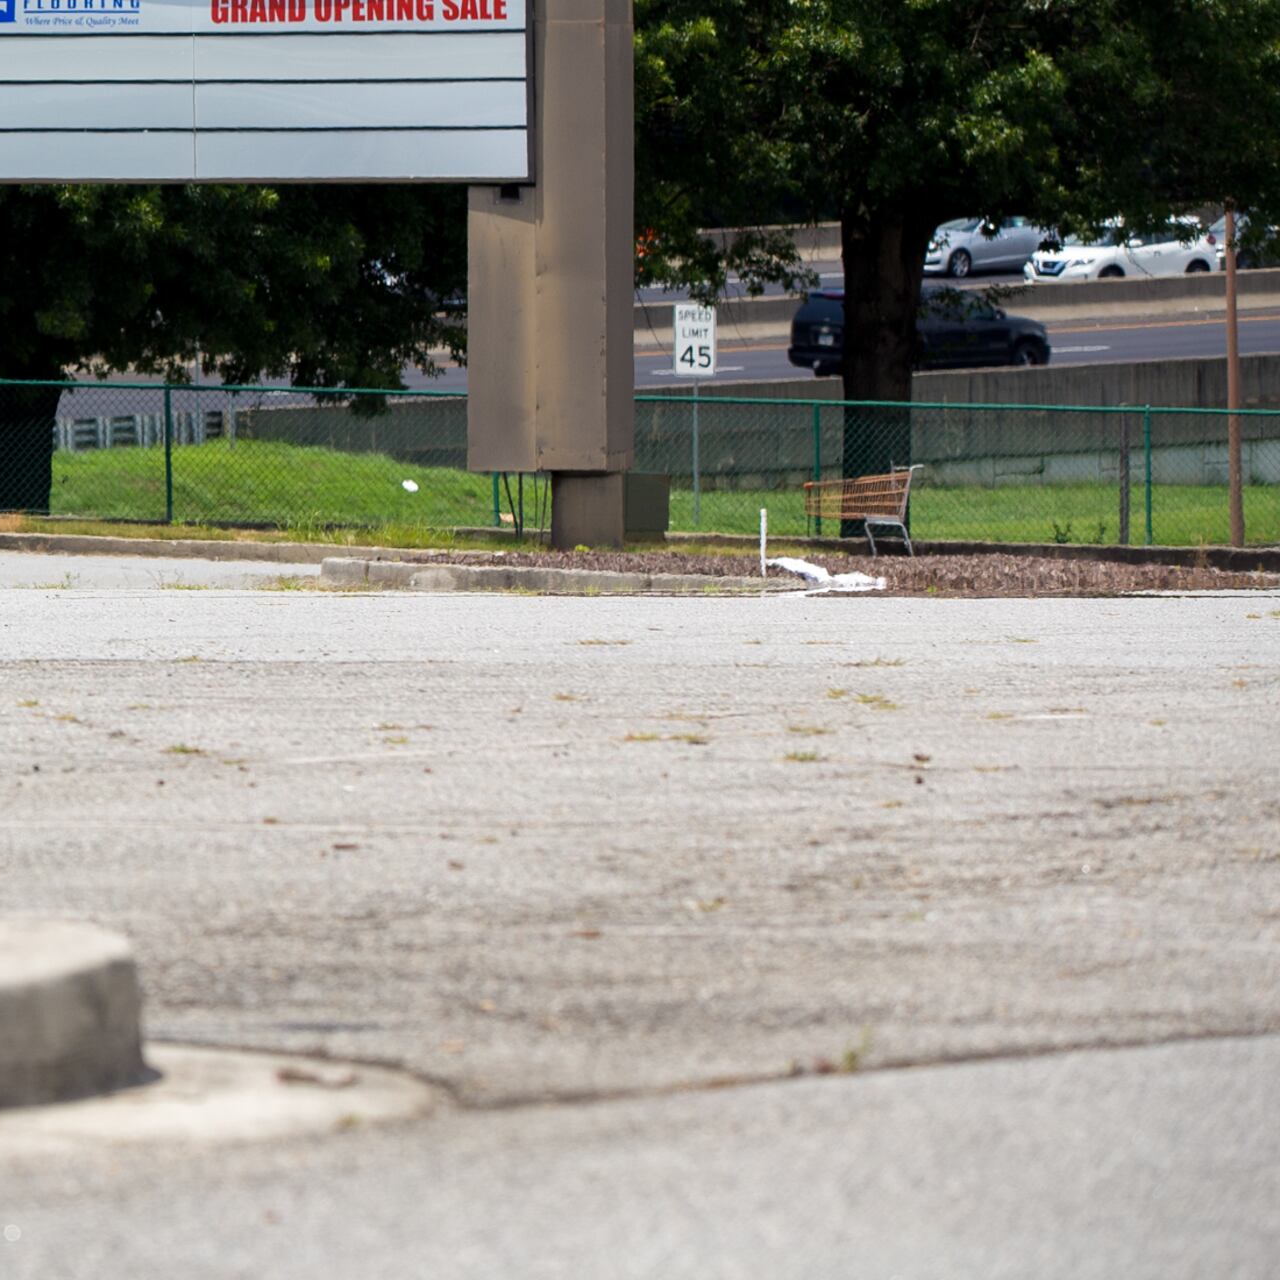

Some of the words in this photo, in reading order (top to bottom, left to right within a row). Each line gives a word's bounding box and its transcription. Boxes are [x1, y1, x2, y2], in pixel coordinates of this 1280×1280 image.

[25, 15, 51, 26] Where
[52, 15, 73, 26] Price
[85, 15, 117, 28] Quality
[118, 15, 140, 26] Meet
[678, 309, 712, 322] SPEED
[682, 328, 709, 338] LIMIT
[680, 345, 711, 368] 45
